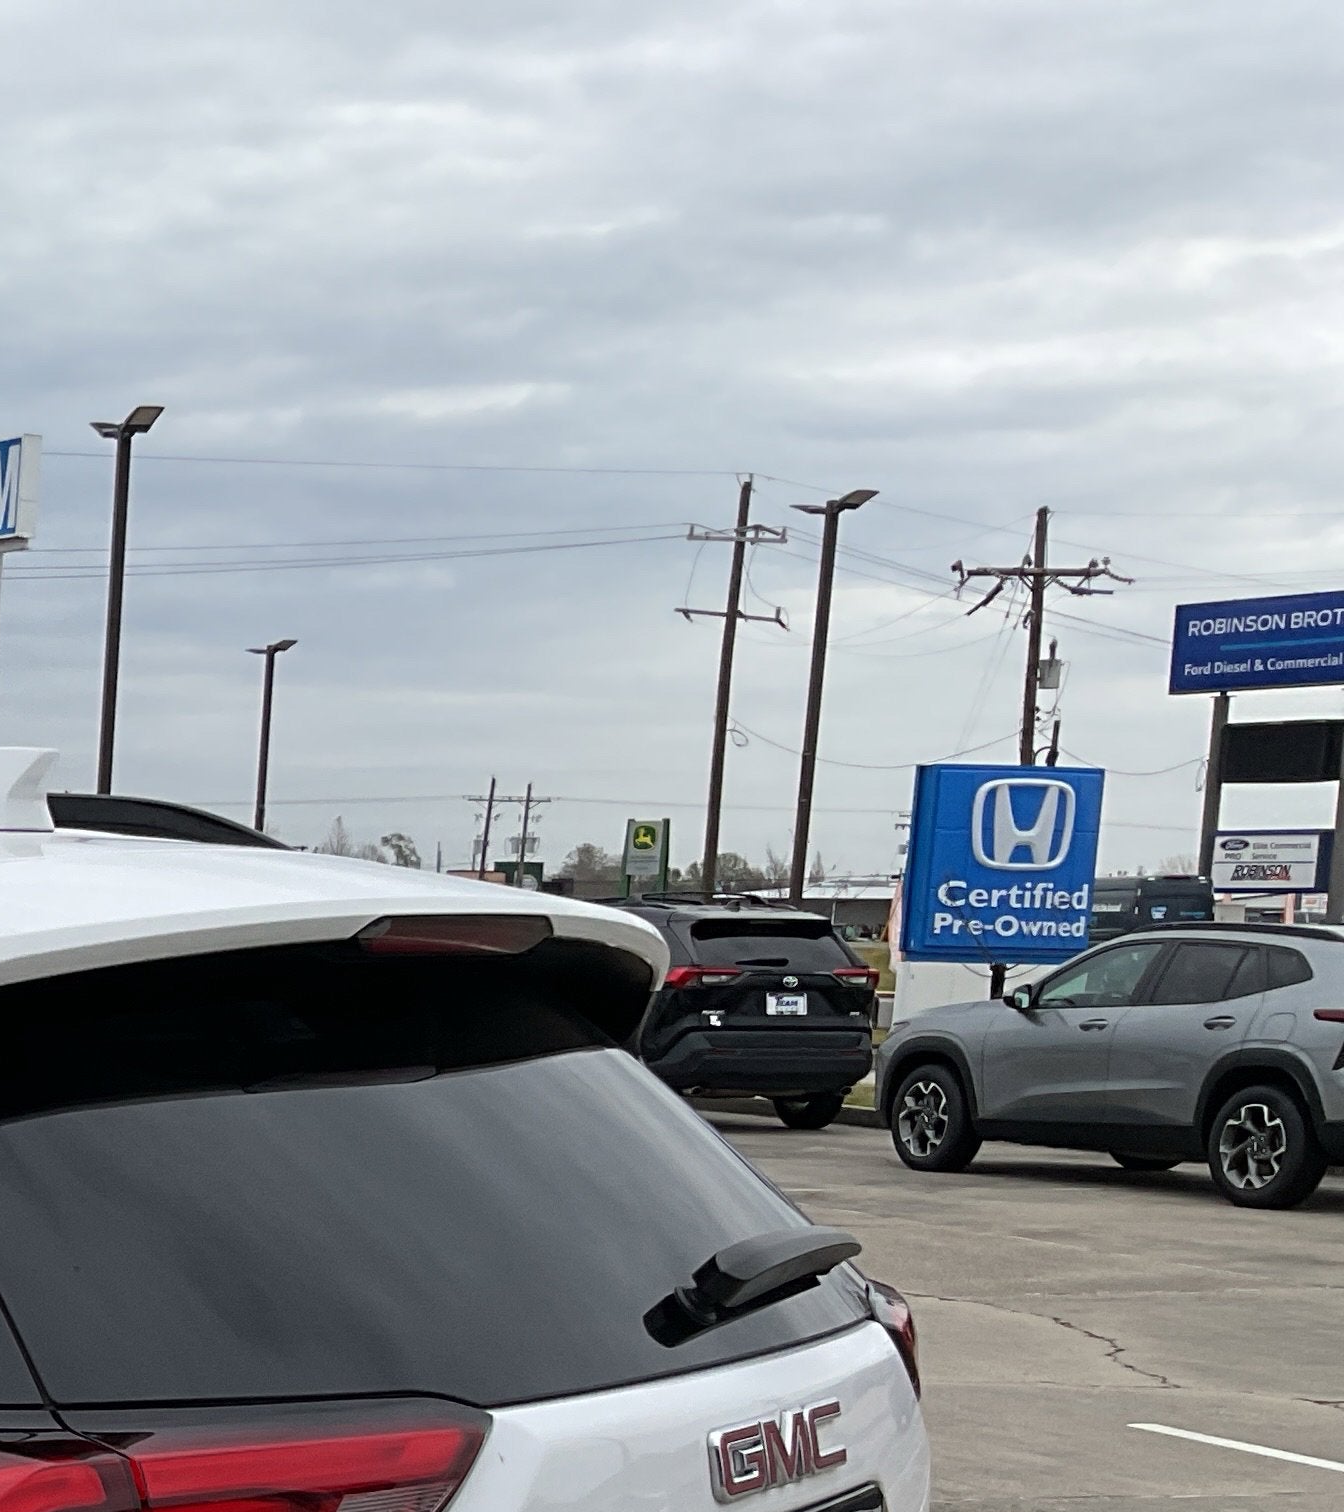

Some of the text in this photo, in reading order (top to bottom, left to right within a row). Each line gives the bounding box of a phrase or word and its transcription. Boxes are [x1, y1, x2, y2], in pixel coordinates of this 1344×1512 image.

[1188, 613, 1286, 637] ROBINSON
[1184, 652, 1343, 676] Ford Diesel & Commercial
[1231, 864, 1292, 877] ROBINSON
[937, 879, 1090, 910] Certified
[932, 912, 1086, 938] Pre-Owned
[710, 1398, 848, 1501] GMC
